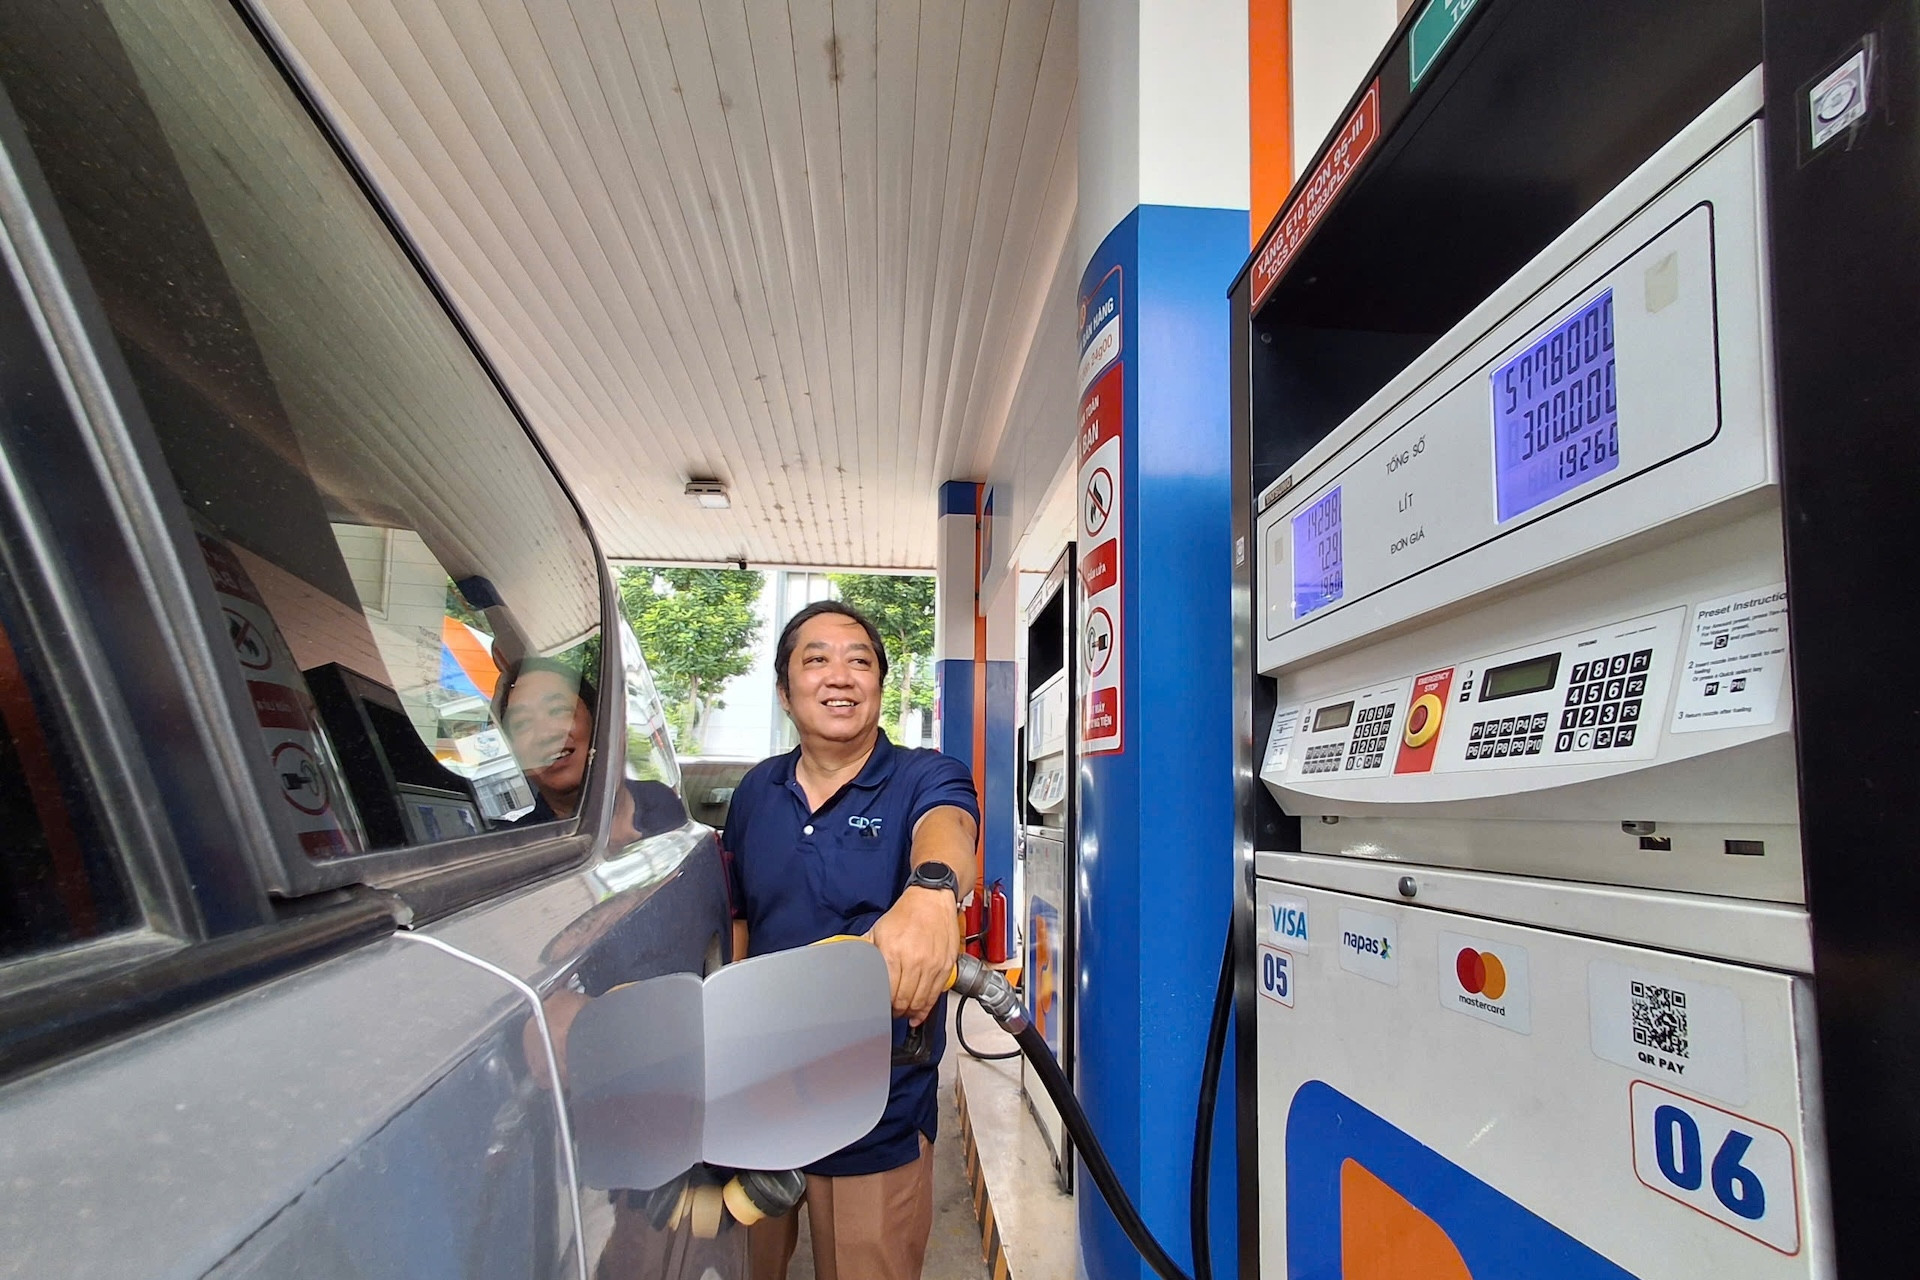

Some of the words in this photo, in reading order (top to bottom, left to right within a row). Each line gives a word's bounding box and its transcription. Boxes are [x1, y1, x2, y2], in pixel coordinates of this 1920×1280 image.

[1258, 235, 1284, 278] XĂNG
[1286, 207, 1304, 233] E10
[1307, 162, 1331, 209] RON
[1333, 113, 1365, 164] 95-III
[1267, 246, 1288, 279] TCCS
[1290, 230, 1299, 249] 07
[1307, 154, 1350, 226] 2023/PLX
[1093, 297, 1113, 330] HÀNG
[1386, 451, 1409, 475] TỔNG
[1412, 435, 1426, 458] SỐ
[1398, 493, 1413, 512] LÍT
[1308, 494, 1341, 541] 14298
[1409, 526, 1425, 544] GIÁ
[1698, 605, 1730, 619] Preset
[1575, 665, 1587, 682] 7
[1593, 662, 1605, 678] 8
[1613, 658, 1625, 674] 9
[1634, 655, 1647, 667] F1
[1688, 661, 1693, 669] 2
[1424, 683, 1438, 692] STOP
[1570, 689, 1579, 703] 4
[1588, 685, 1599, 701] 5
[1608, 681, 1620, 697] 6
[1628, 680, 1643, 692] F2
[1706, 685, 1717, 694] P1
[1360, 711, 1364, 721] 7
[1368, 710, 1373, 720] 8
[1377, 708, 1383, 718] 9
[1566, 712, 1574, 727] 1
[1583, 709, 1595, 724] 2
[1603, 705, 1614, 722] 3
[1623, 704, 1637, 716] F3
[1355, 727, 1360, 738] 4
[1364, 725, 1370, 736] 5
[1373, 723, 1379, 734] 6
[1472, 726, 1483, 738] P1
[1485, 724, 1498, 736] P2
[1501, 722, 1513, 734] P3
[1516, 720, 1529, 731] P4
[1532, 718, 1546, 729] P5
[1353, 742, 1357, 753] 1
[1361, 741, 1366, 752] 2
[1370, 740, 1375, 751] 3
[1467, 746, 1479, 758] P6
[1481, 745, 1494, 757] P7
[1496, 743, 1508, 754] P8
[1511, 740, 1524, 752] P9
[1526, 738, 1541, 751] P10
[1559, 734, 1570, 750] 0
[1578, 731, 1590, 746] C
[1618, 729, 1632, 742] F4
[1348, 758, 1353, 769] 0
[1357, 758, 1362, 767] C
[1269, 904, 1307, 940] VISA
[1343, 931, 1379, 955] napas
[1263, 953, 1288, 997] 05
[1459, 994, 1506, 1016] mastercard
[1638, 1051, 1655, 1065] QR
[1659, 1055, 1685, 1075] PAY
[1654, 1105, 1766, 1220] 06
